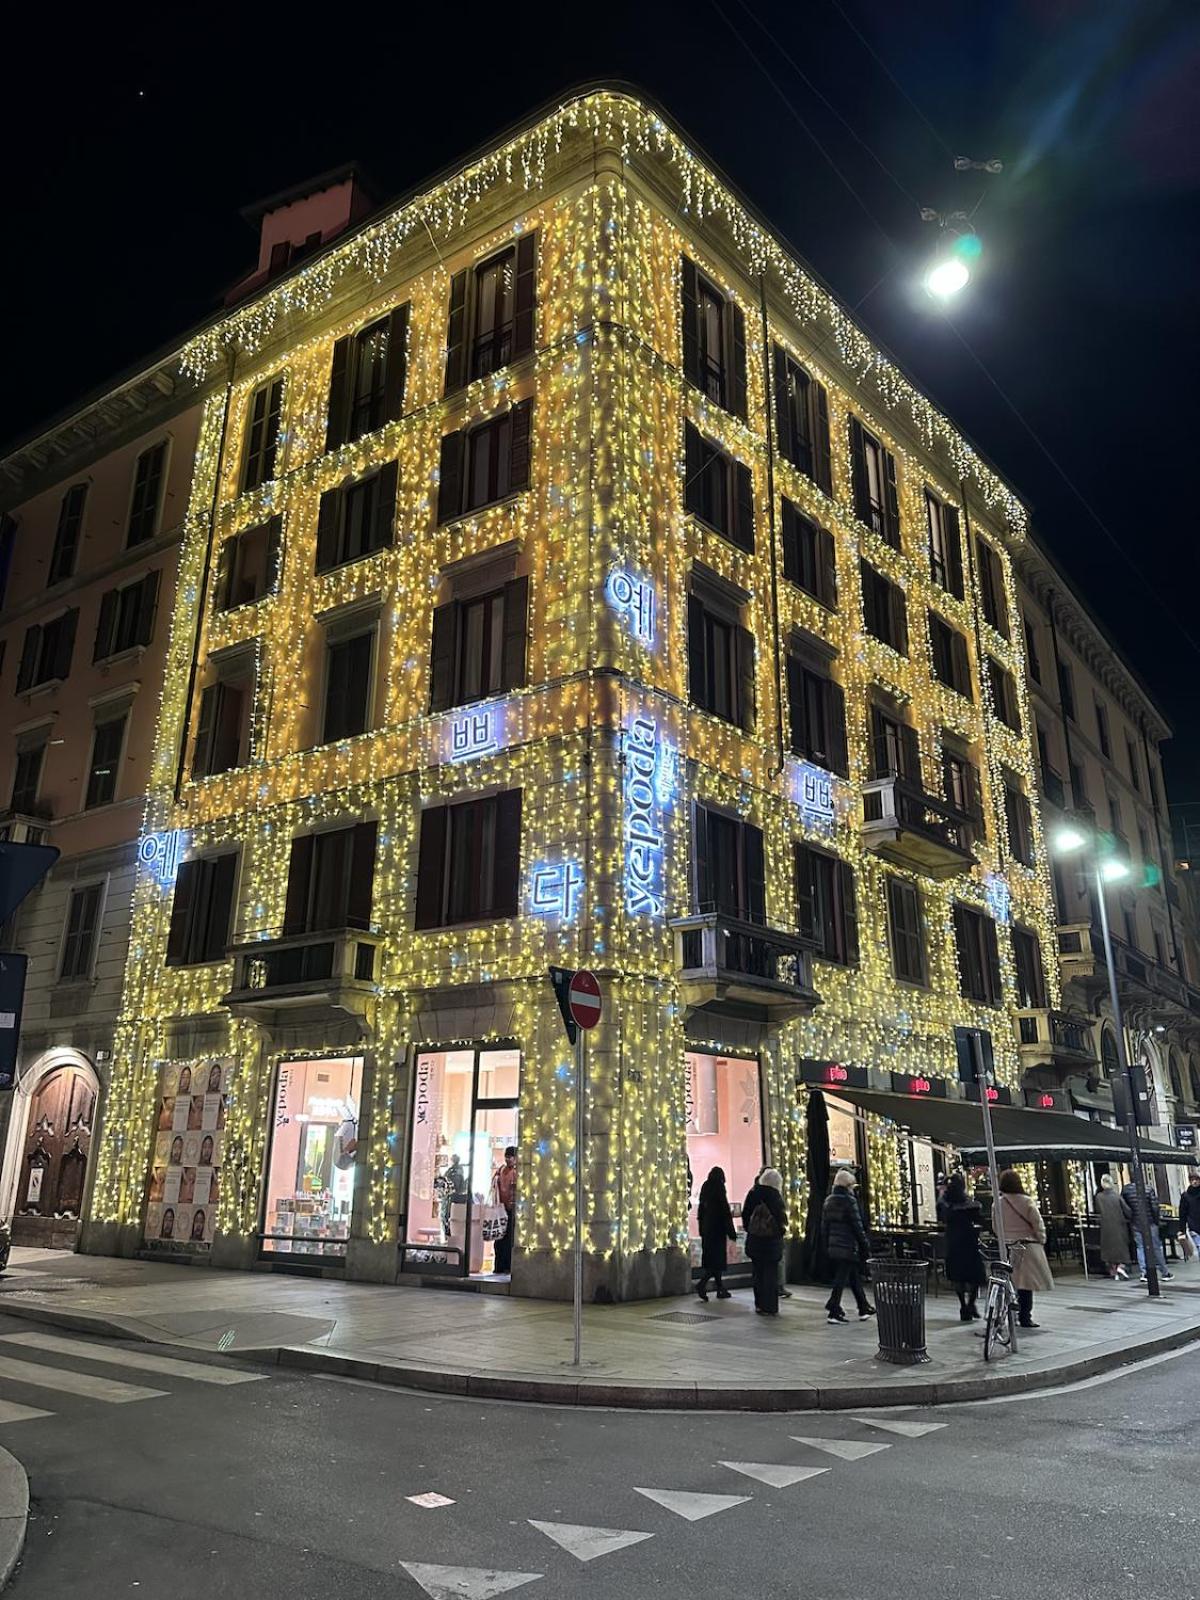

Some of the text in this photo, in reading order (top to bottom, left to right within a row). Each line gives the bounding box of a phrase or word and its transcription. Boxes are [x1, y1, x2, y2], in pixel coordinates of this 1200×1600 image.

[611, 572, 655, 641] 예
[450, 711, 497, 762] 쁘
[627, 718, 662, 916] yepoda
[803, 772, 834, 818] 쁘
[140, 830, 179, 880] 예
[532, 863, 581, 919] 다
[276, 1069, 289, 1127] yepoda
[416, 1061, 429, 1125] yepoda
[830, 1065, 848, 1081] pho
[915, 1077, 930, 1092] pho
